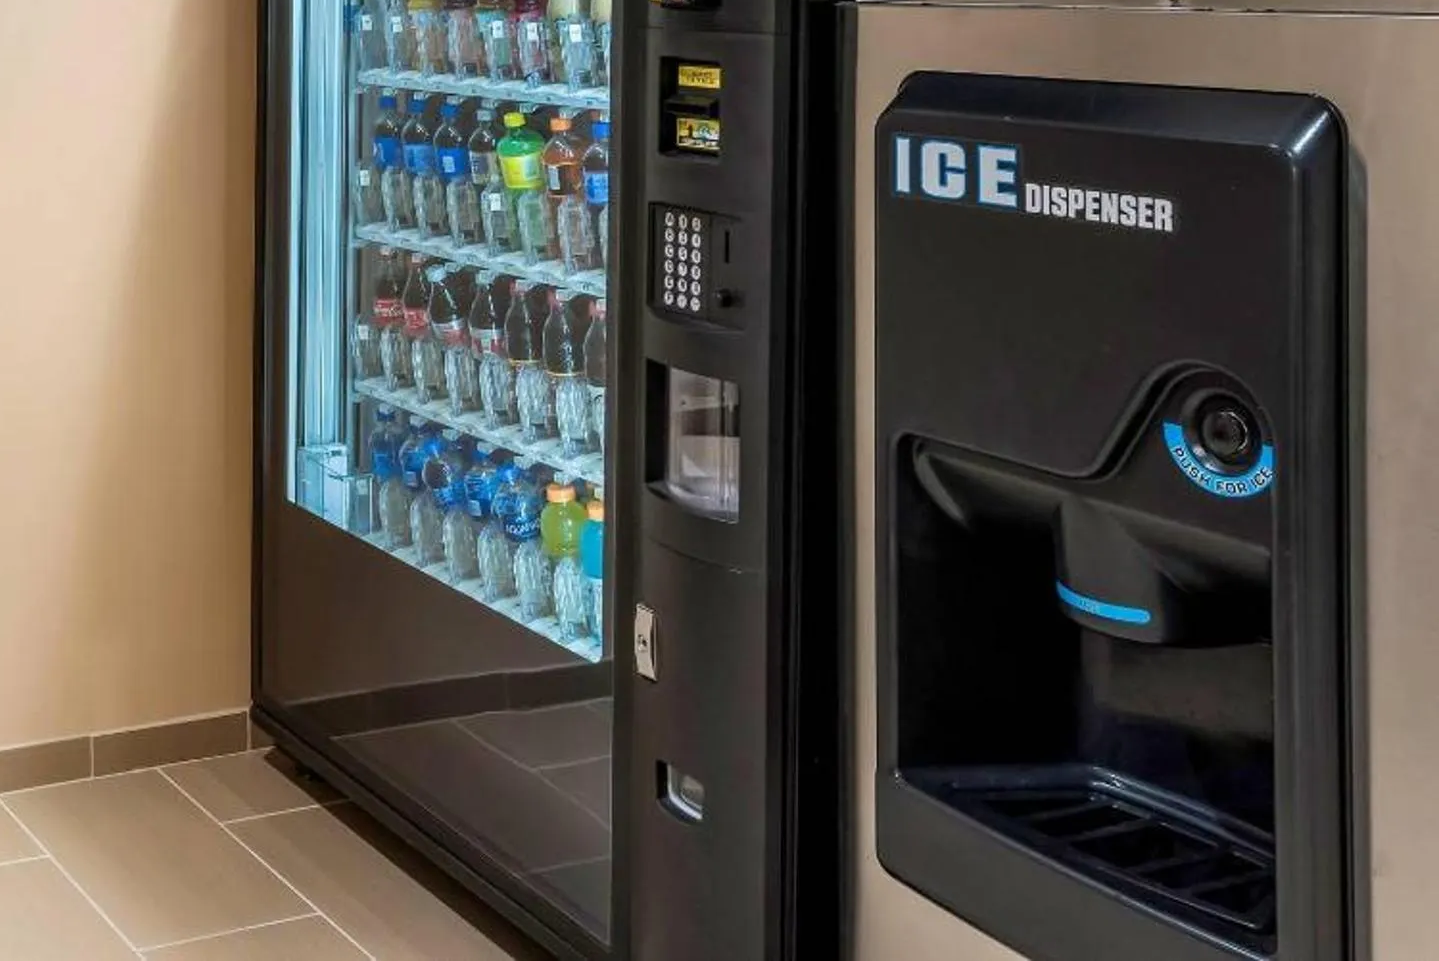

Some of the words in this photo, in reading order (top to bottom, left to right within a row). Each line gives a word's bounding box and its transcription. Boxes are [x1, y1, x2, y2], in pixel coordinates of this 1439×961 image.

[895, 137, 1018, 208] ICE
[1025, 183, 1174, 232] DISPENSER
[1174, 446, 1210, 486] PUSH
[1216, 480, 1248, 494] FOR
[1250, 465, 1273, 489] ICE
